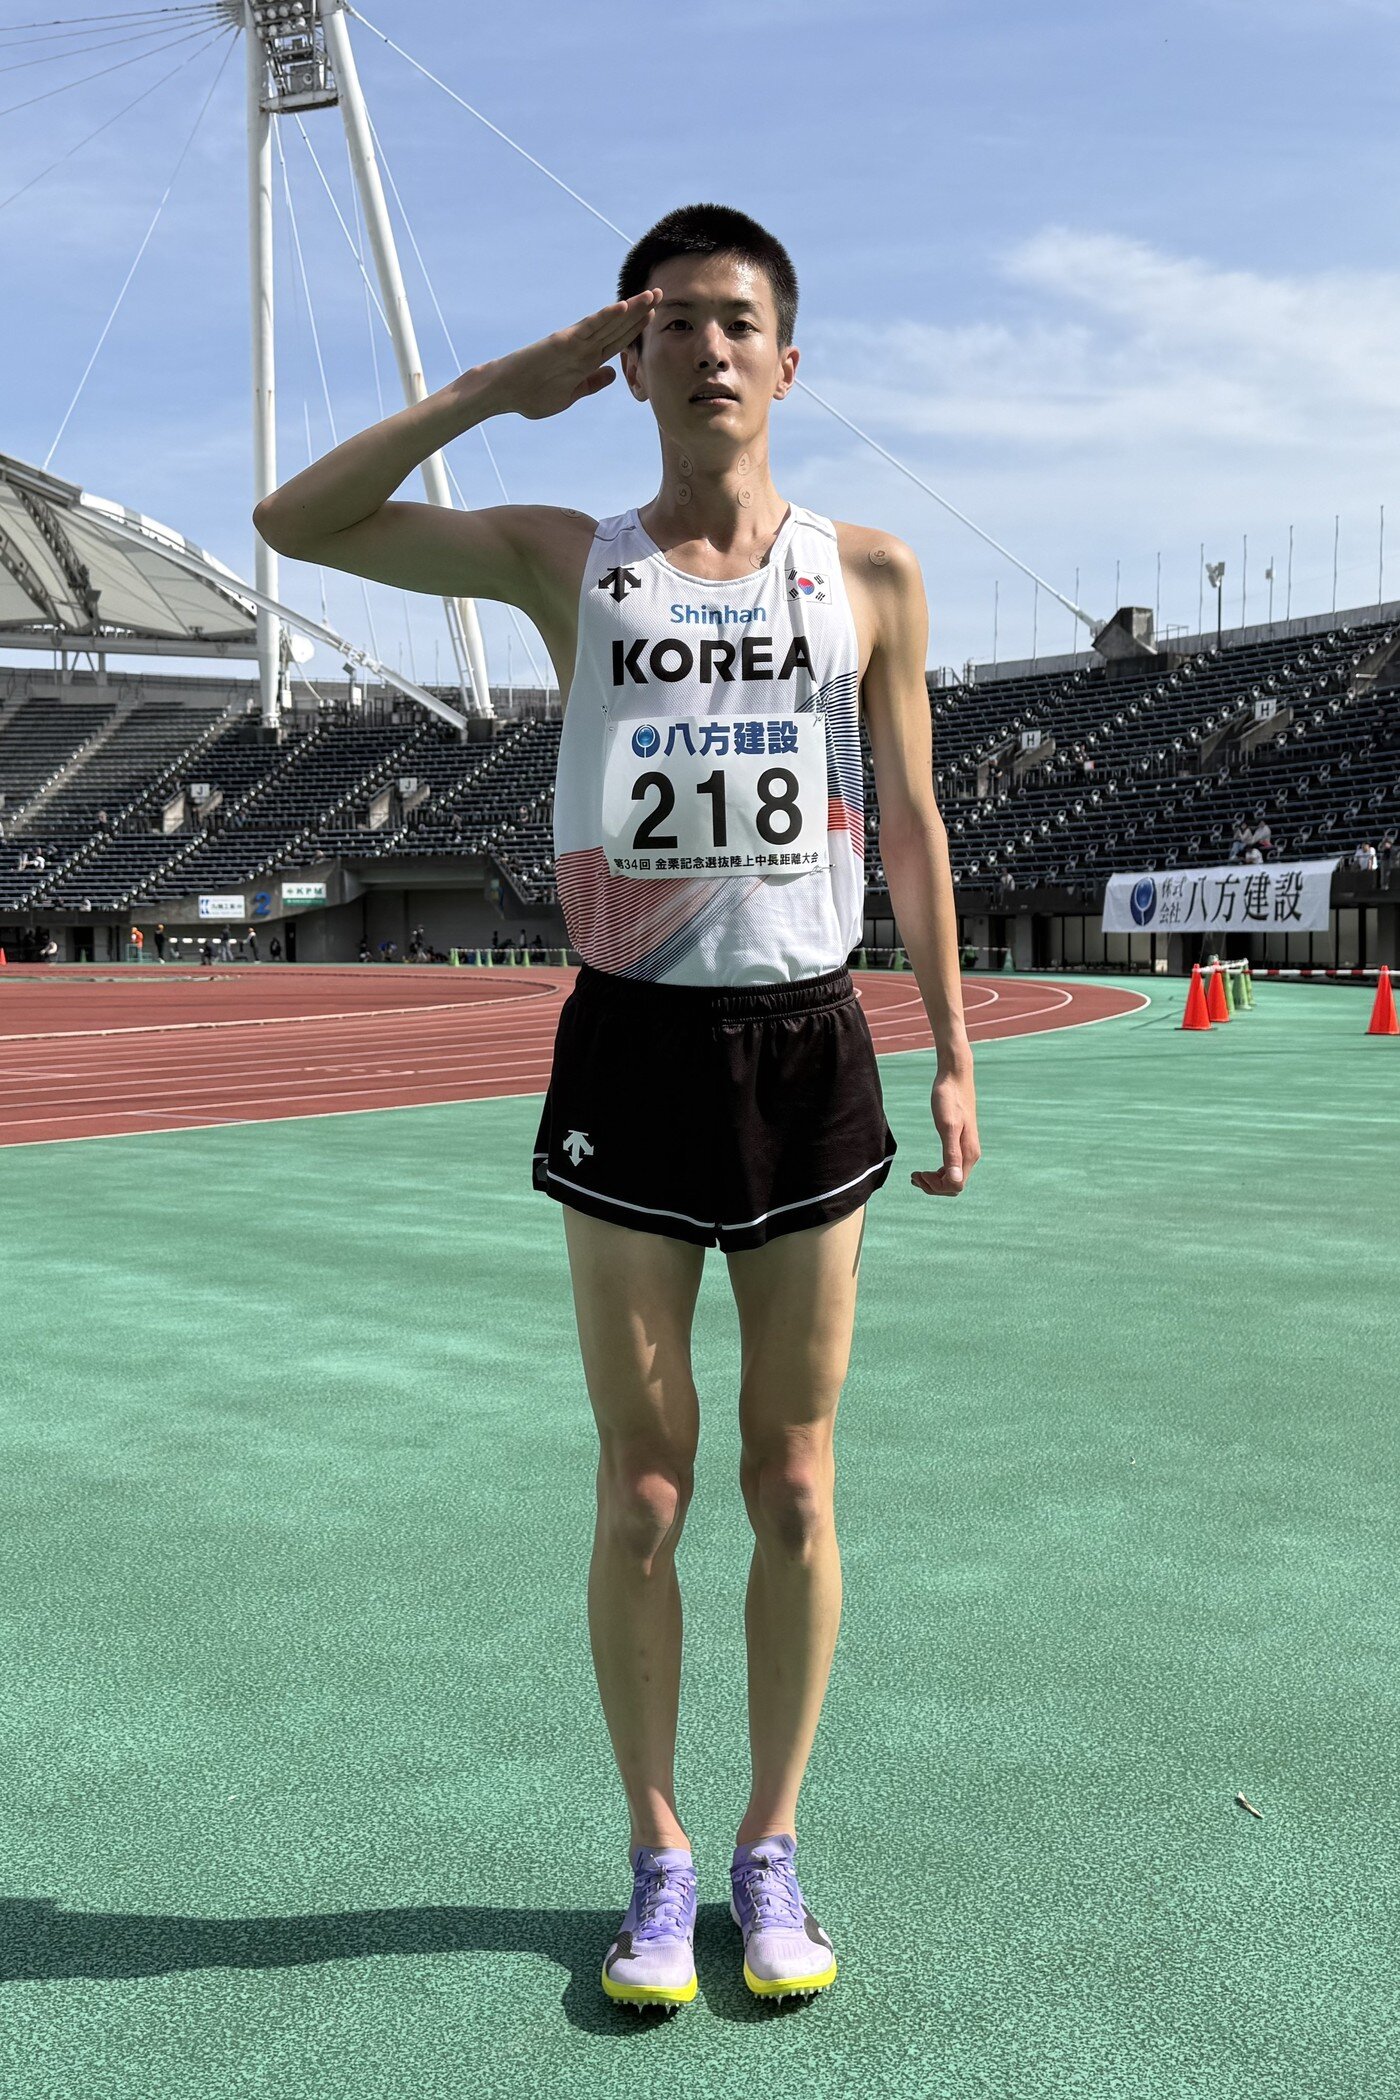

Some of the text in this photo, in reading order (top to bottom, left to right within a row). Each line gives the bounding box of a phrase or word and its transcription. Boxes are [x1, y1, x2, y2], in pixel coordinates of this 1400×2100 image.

[670, 604, 767, 625] Shinhan
[612, 636, 816, 686] KOREA
[1261, 702, 1270, 717] H
[663, 720, 799, 757] 八方建設
[1026, 733, 1035, 746] H
[631, 767, 803, 850] 218
[614, 858, 651, 871] 第34回
[254, 891, 273, 916] 2
[1184, 870, 1303, 923] 八方建設
